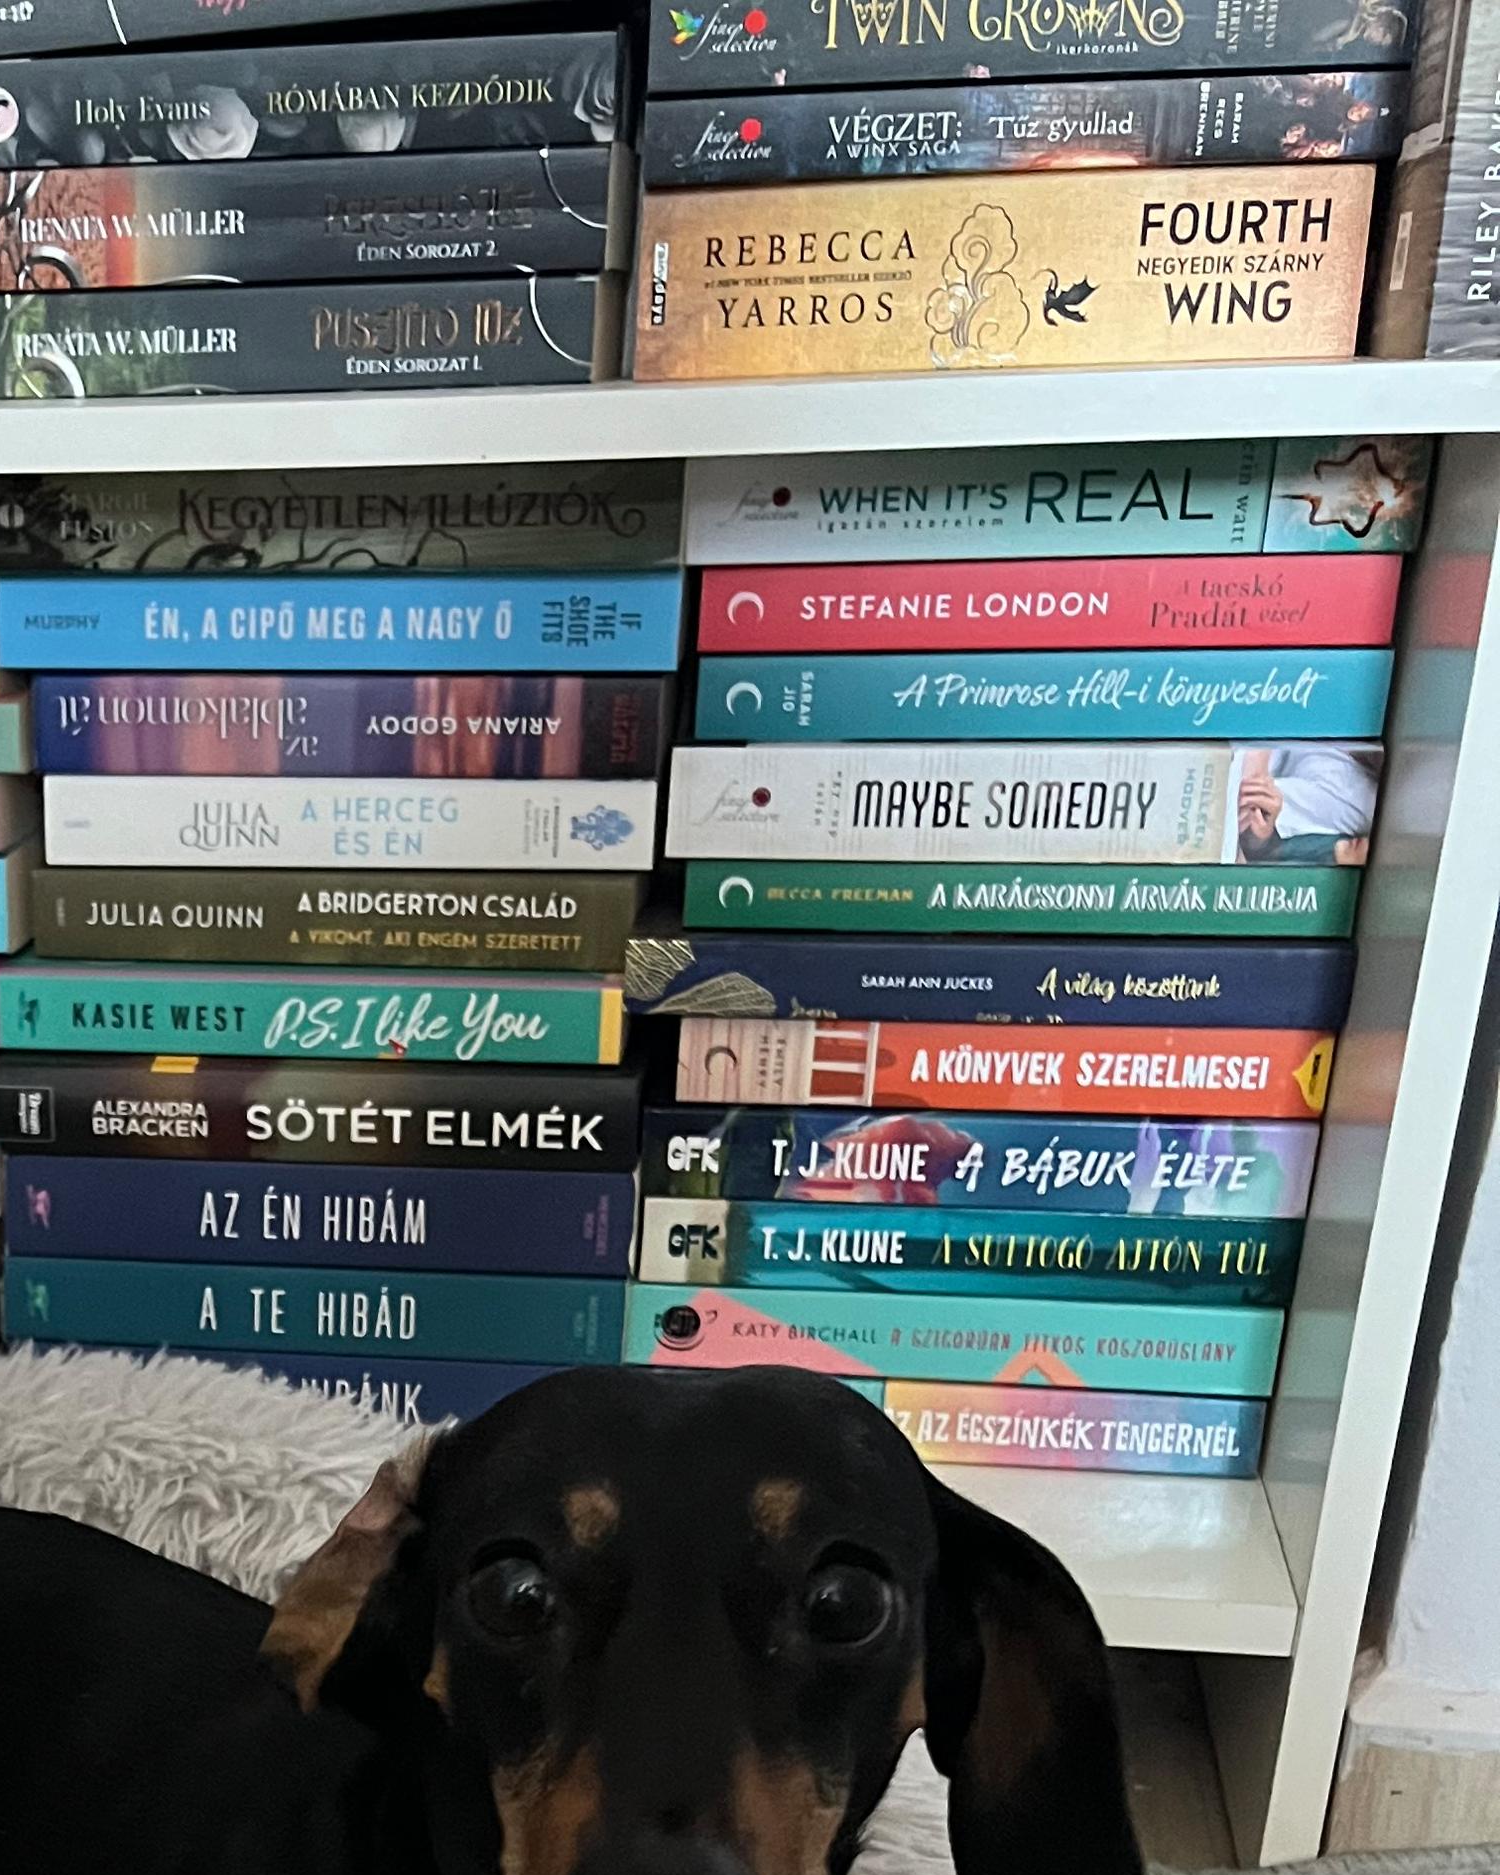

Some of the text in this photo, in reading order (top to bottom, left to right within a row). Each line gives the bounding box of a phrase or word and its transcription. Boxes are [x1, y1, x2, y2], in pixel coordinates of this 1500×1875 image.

[267, 74, 554, 114] RÓMÁBAN KEZDŐDIK
[75, 96, 211, 130] Holy Evans
[828, 107, 963, 144] VÉGZET:
[989, 111, 1134, 143] Tűz gyullad
[1195, 81, 1211, 156] BRENNAN
[826, 140, 961, 159] A WINX SAGA
[147, 208, 245, 237] MÜLLER
[1140, 198, 1332, 247] FOURTH
[357, 242, 480, 262] ÉDEN SOROZAT
[704, 229, 917, 268] REBECCA
[1137, 250, 1325, 277] NEGYEDIK SZÁRNY
[1467, 201, 1500, 300] RILEY
[717, 291, 894, 329] YARROS
[1164, 280, 1292, 325] WING
[105, 325, 237, 356] W. MÜLLER
[346, 356, 468, 375] ÉDEN SOROZAT
[818, 482, 1008, 514] WHEN IT'S
[1025, 467, 1214, 523] REAL
[178, 488, 408, 542] KEGYETLEN
[1230, 494, 1250, 543] watt
[1199, 573, 1284, 597] tacskó
[24, 614, 100, 630] MURPHY
[144, 600, 512, 643] ÉN, A CIPŐ MEG A NAGY Ő
[541, 595, 642, 648] IF THE SHOE FITS
[800, 591, 1109, 621] STEFANIE LONDON
[1150, 599, 1250, 628] Pradát
[782, 671, 815, 726] SARAH JIO
[892, 666, 1329, 726] A Primrose Hill-i könyvesbolt
[57, 695, 308, 740] ablakomon át
[366, 715, 562, 736] ARIANA GODOY
[191, 801, 270, 826] JULIA
[301, 797, 460, 823] A HERCEG
[853, 780, 1157, 829] MAYBE SOMEDAY
[1176, 763, 1214, 849] COLLEEN HOOVER
[179, 823, 280, 851] QUINN
[333, 826, 423, 856] ÉS ÉN
[297, 891, 578, 919] A BRIDGERTON CSALÁD
[766, 887, 914, 901] BECCA FREEMAN
[927, 876, 1319, 913] A KARÁCSONYI ÁRVÁK KLUBJA
[86, 902, 163, 927] JULIA
[171, 904, 264, 929] QUINN
[289, 930, 582, 952] A AKI ENGEM SZERETETT
[861, 974, 994, 991] SARAH ANN JUCKES
[1036, 966, 1116, 1004] A világ
[72, 1002, 245, 1033] KASIE WEST
[342, 991, 549, 1060] I like You
[911, 1048, 929, 1083] A
[937, 1044, 1065, 1086] KÖNYVEK
[1076, 1051, 1270, 1091] SZERELMESEI
[92, 1100, 207, 1118] ALEXANDRA
[92, 1116, 209, 1138] BRACKEN
[246, 1098, 604, 1151] SÖTÉT ELMÉK
[667, 1136, 721, 1173] GFK
[772, 1139, 930, 1182] T. J. KLUNE
[955, 1136, 1256, 1195] A BÁBUK ÉLETE
[200, 1185, 426, 1244] AZ ÉN HIBÁM
[668, 1224, 720, 1260] GFK
[761, 1227, 906, 1265] T. J. KLUNE
[931, 1232, 1203, 1274] A SUTTOGÓ AJTÓN
[200, 1286, 416, 1340] A TE HIBÁD
[731, 1321, 877, 1345] KATY BIRCHALL
[916, 1403, 1241, 1459] AZ ÉGSZÍNKÉK TENGERNÉL
